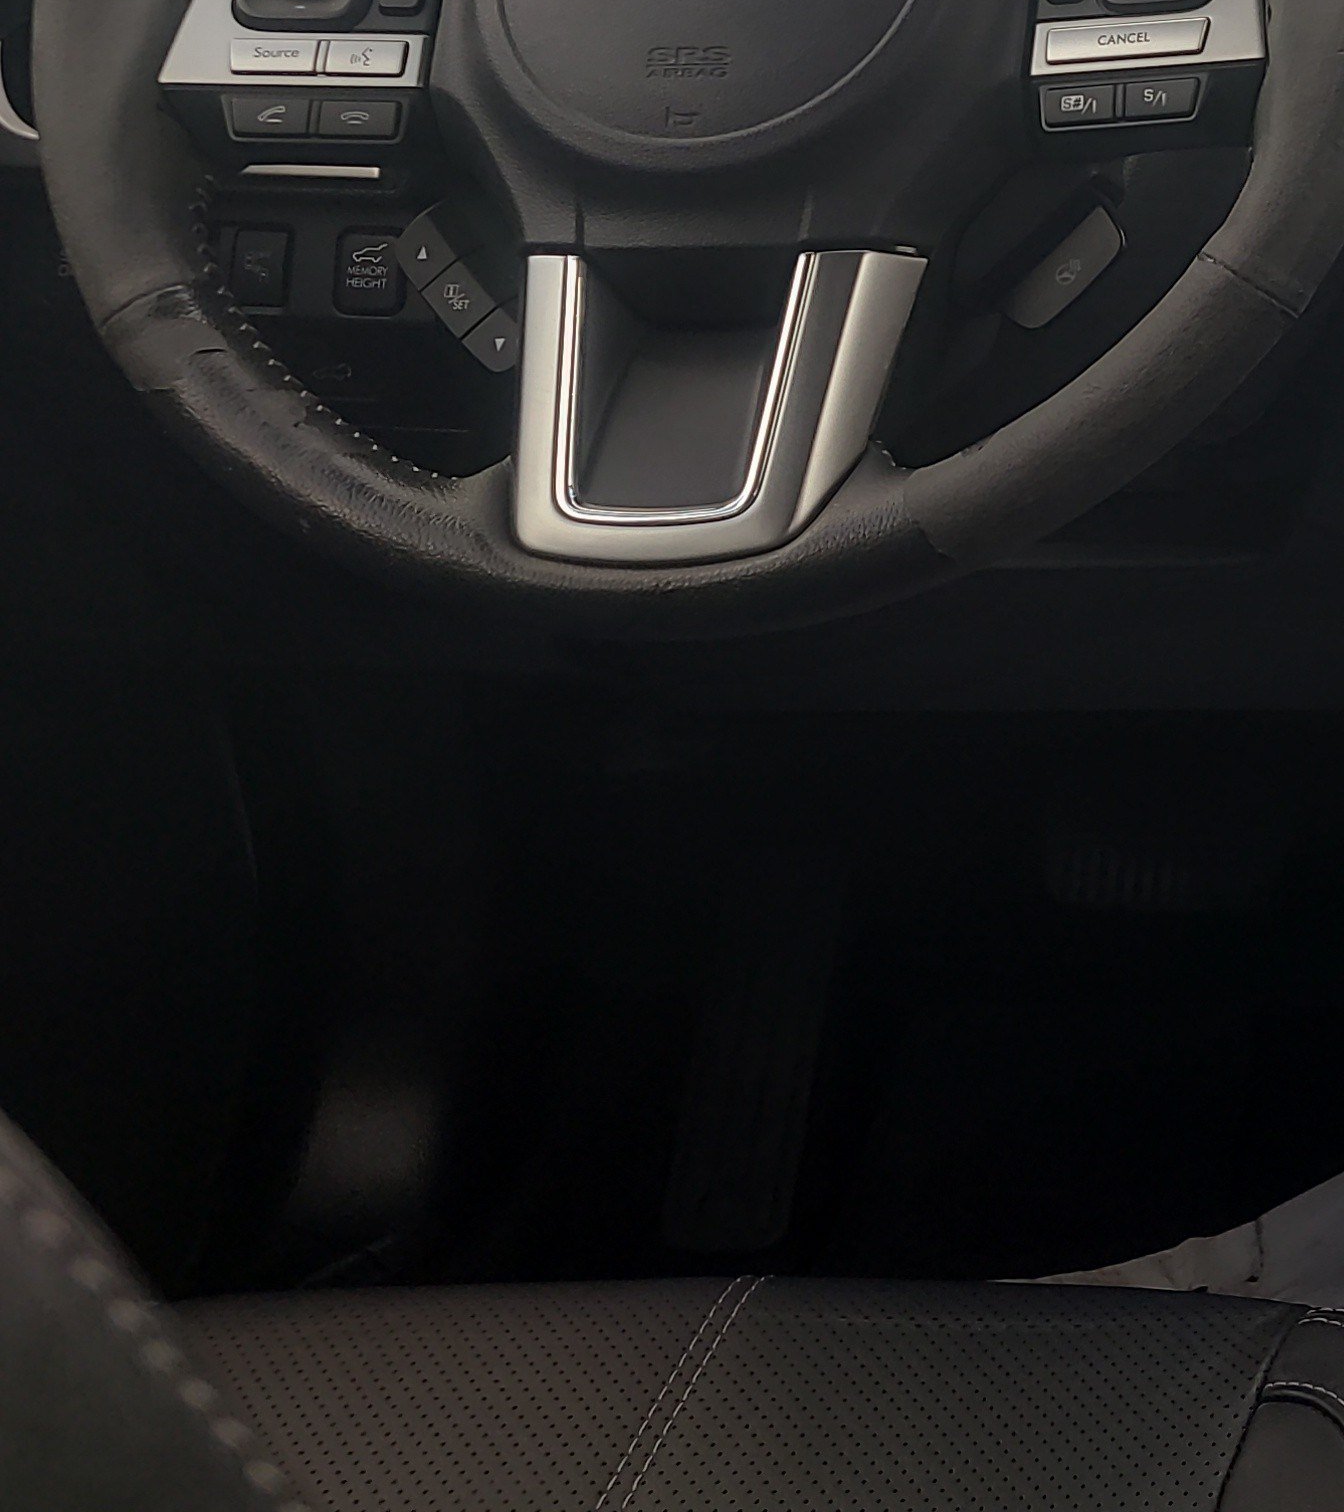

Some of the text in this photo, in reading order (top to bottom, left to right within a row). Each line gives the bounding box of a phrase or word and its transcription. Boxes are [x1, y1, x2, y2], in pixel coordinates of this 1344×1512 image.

[1097, 31, 1151, 47] CANCEL
[253, 46, 300, 59] Source
[645, 45, 732, 63] SRS
[347, 265, 388, 277] MEMORY
[345, 277, 388, 289] HEIGHT
